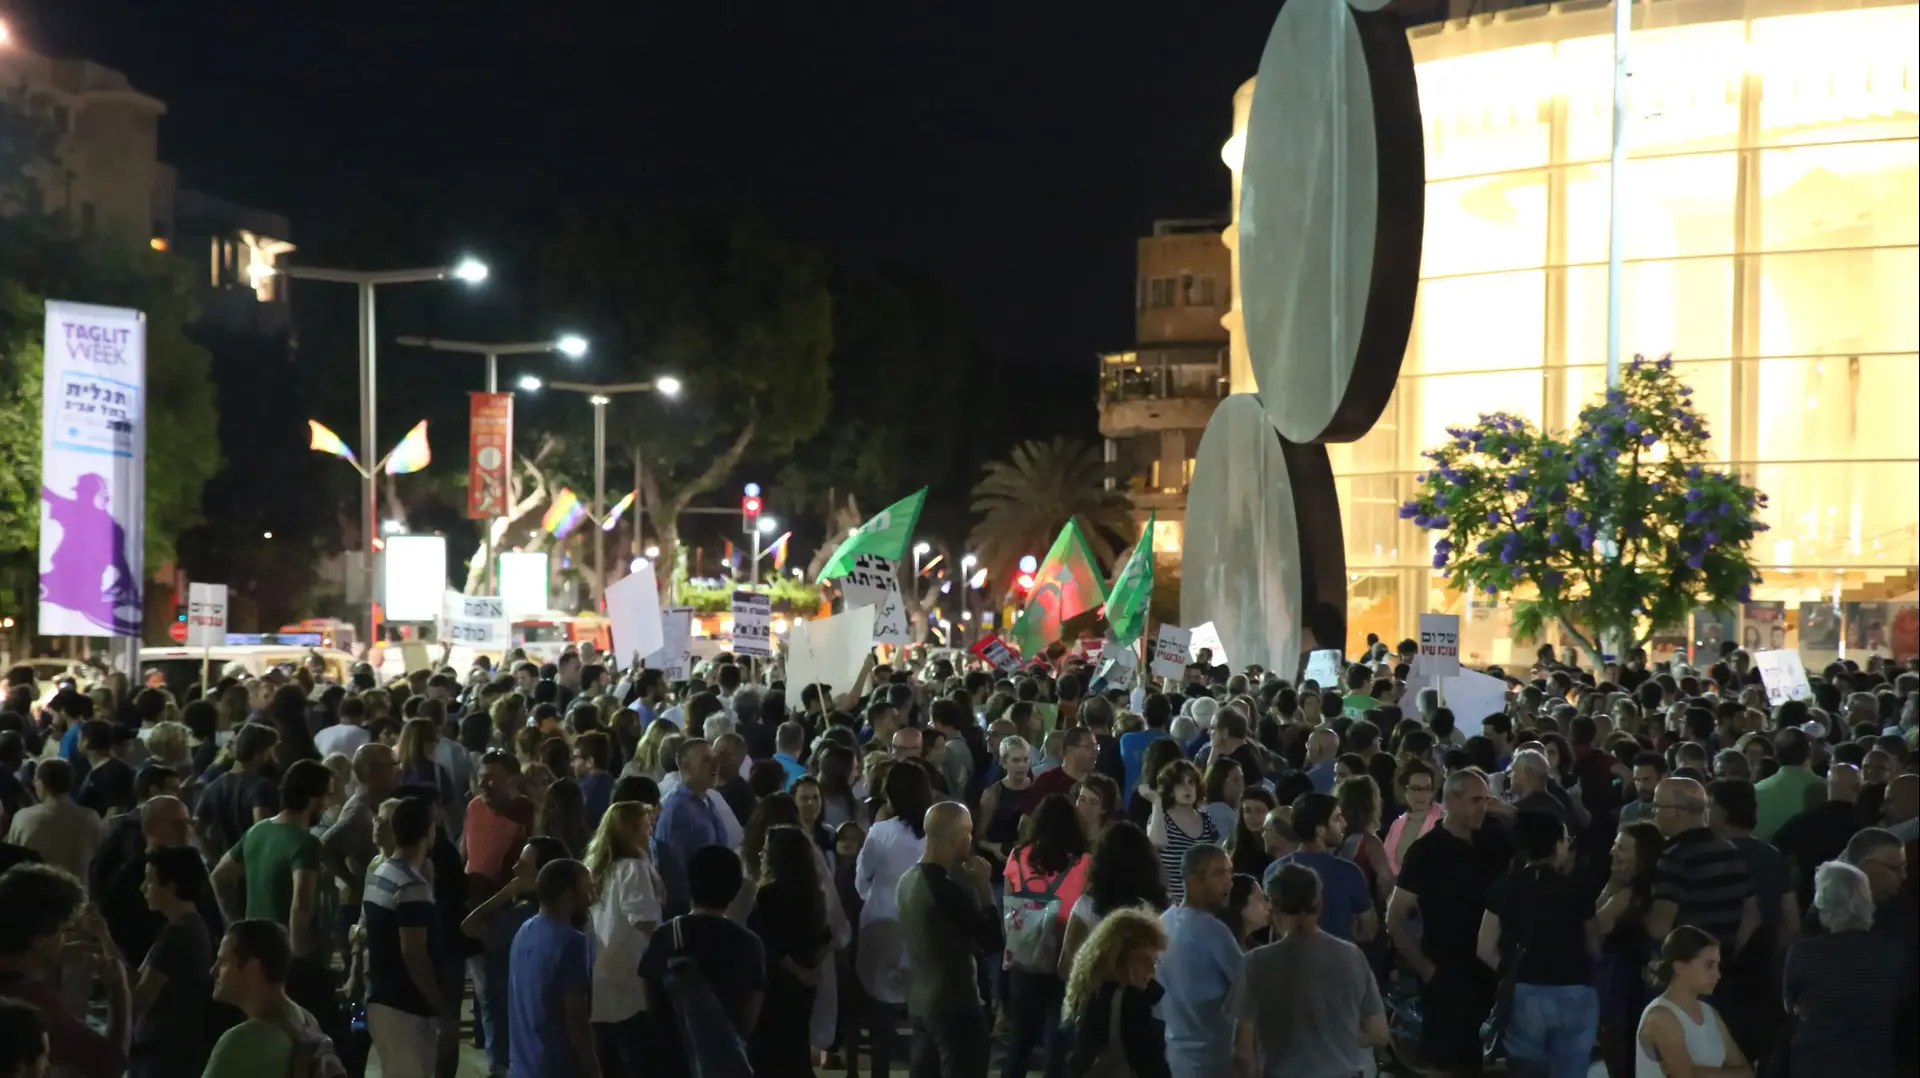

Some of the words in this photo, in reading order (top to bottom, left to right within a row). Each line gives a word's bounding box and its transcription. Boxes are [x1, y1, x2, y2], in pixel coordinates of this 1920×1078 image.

[62, 322, 131, 344] TAGLIT
[66, 340, 129, 366] WEEK
[65, 382, 126, 405] תגלית
[845, 570, 897, 592] הביתה
[1159, 636, 1188, 653] שלום
[1421, 632, 1457, 643] שלום
[1156, 649, 1186, 665] עכשיו
[1421, 644, 1457, 657] עכשיו
